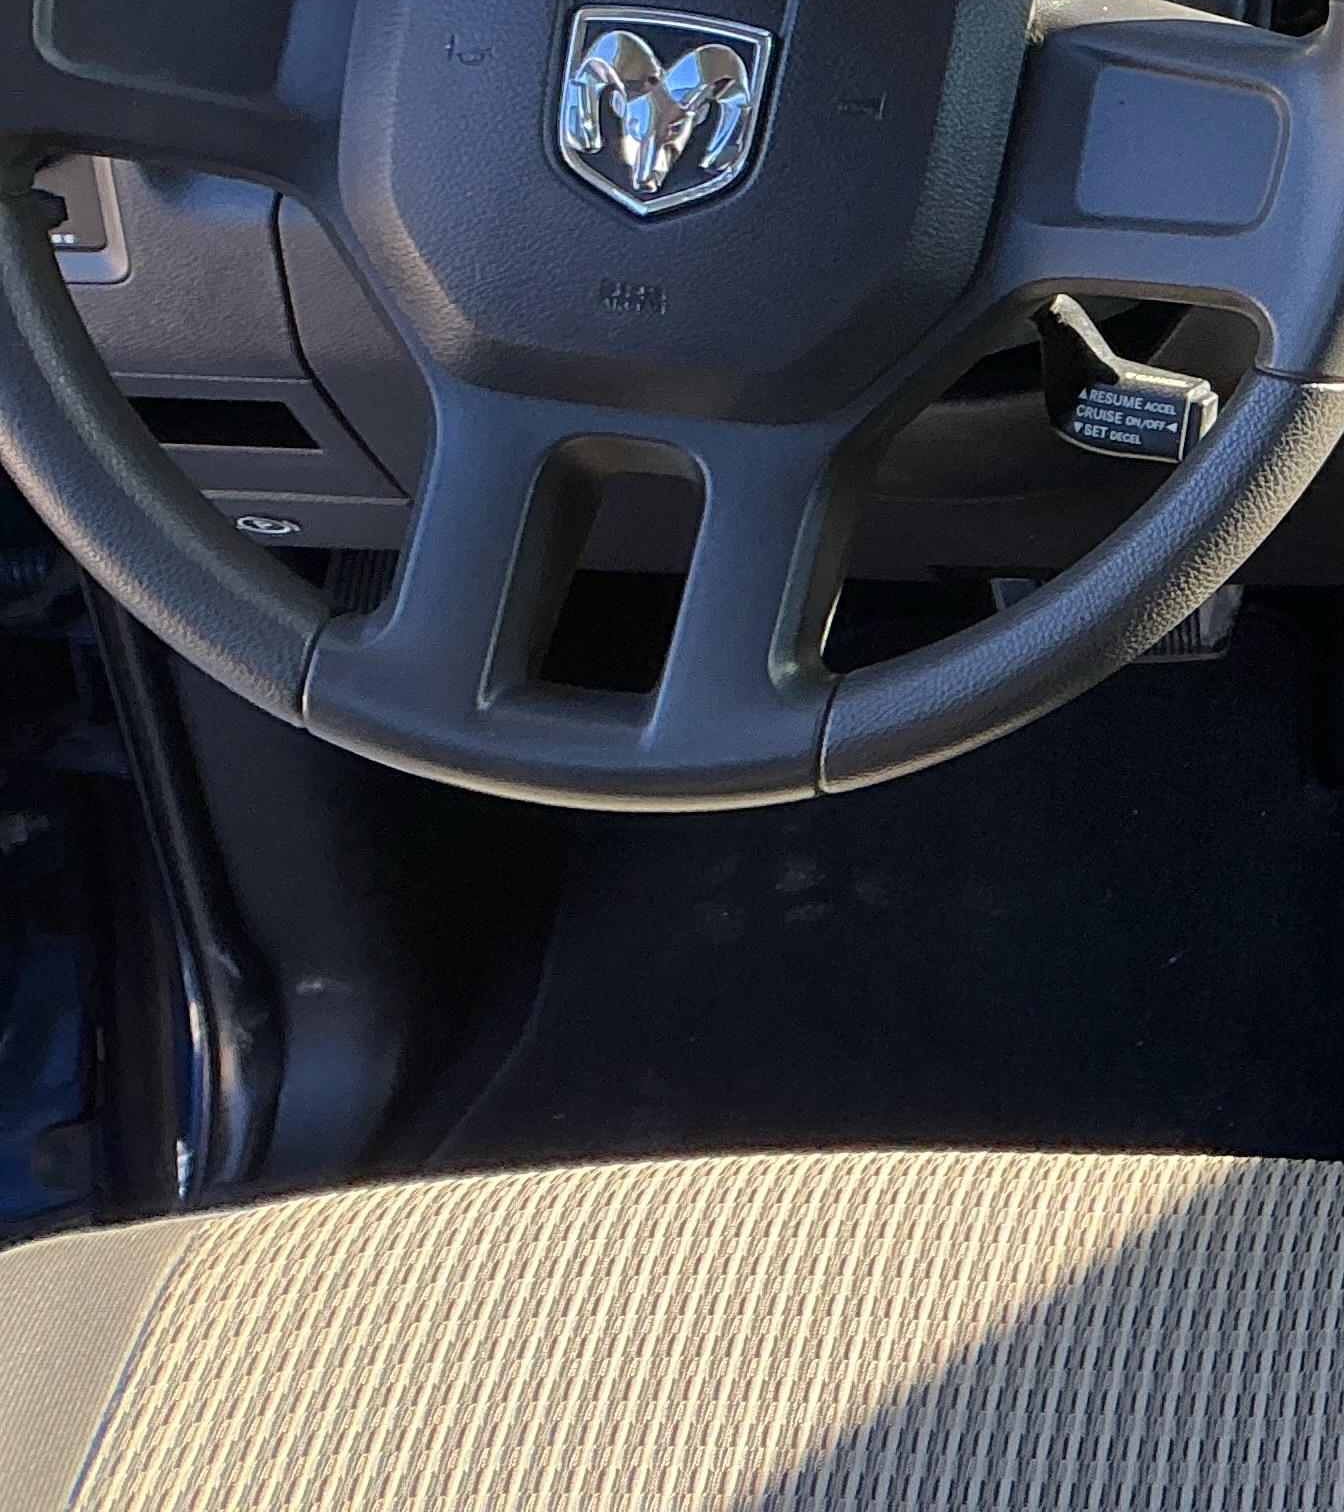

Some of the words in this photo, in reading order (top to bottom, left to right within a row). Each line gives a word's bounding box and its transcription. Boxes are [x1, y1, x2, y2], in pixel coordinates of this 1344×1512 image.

[1089, 389, 1144, 410] RESUME
[1144, 401, 1177, 416] ACCEL
[1076, 404, 1123, 424] CRUISE
[1125, 416, 1167, 431] ON/OFF
[1084, 424, 1109, 439] SET
[1109, 430, 1142, 445] DECEL
